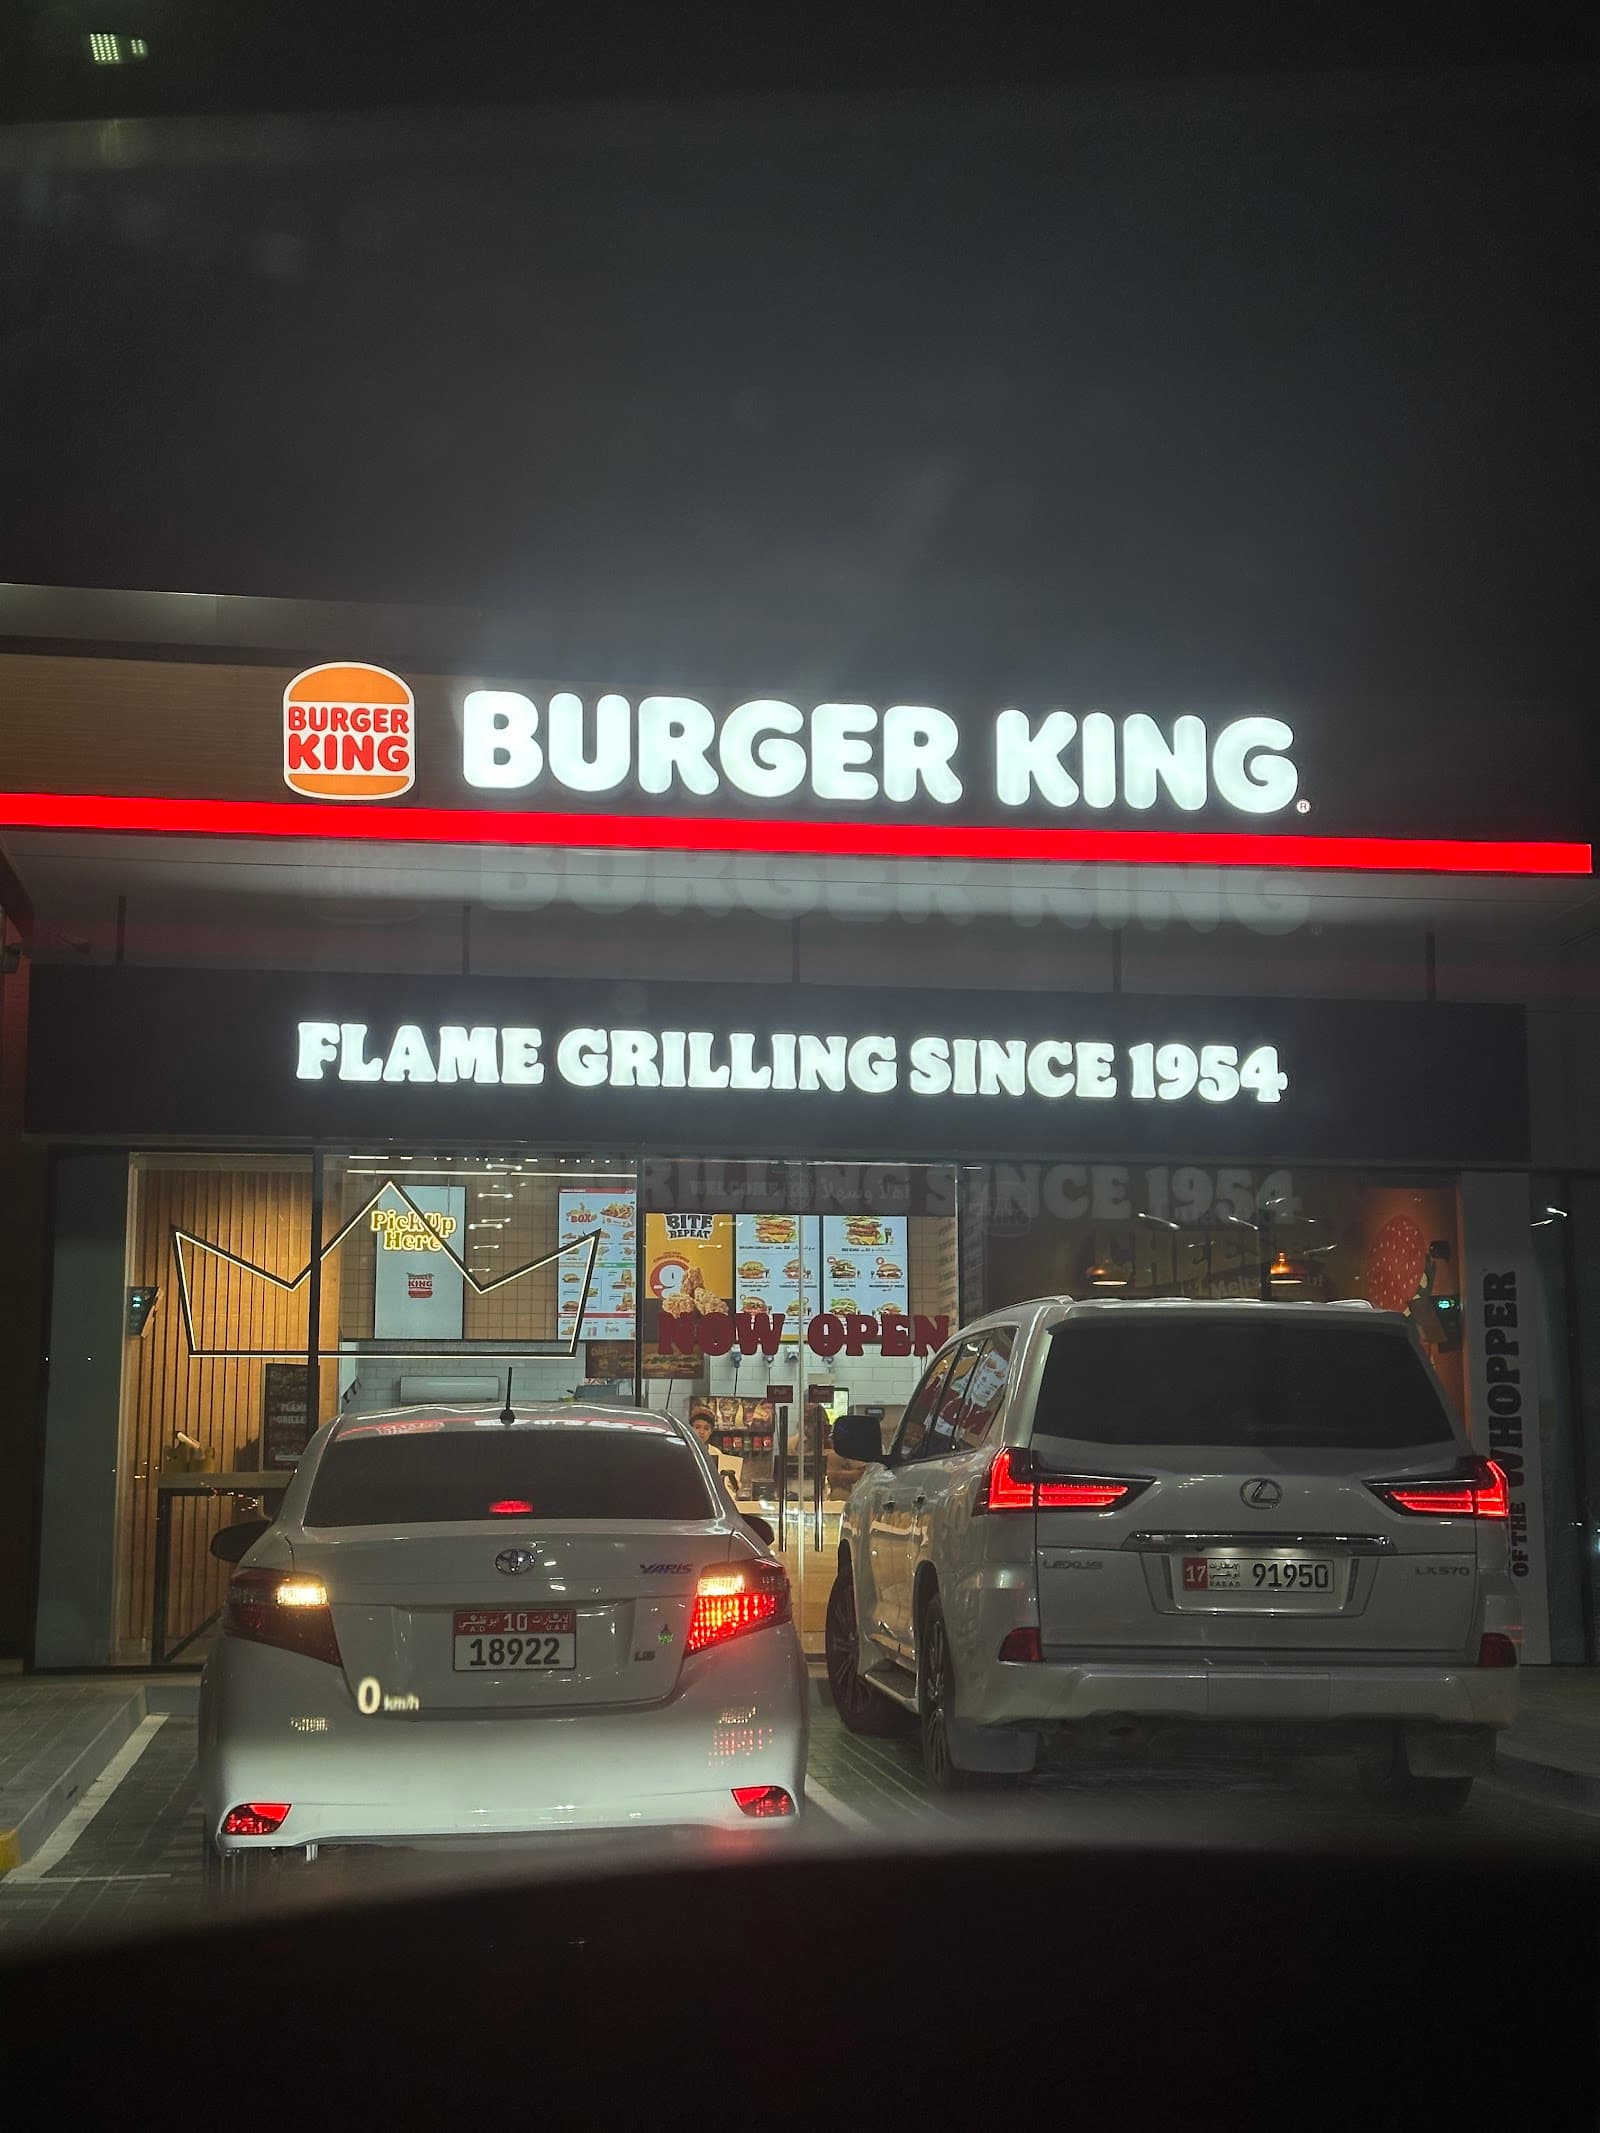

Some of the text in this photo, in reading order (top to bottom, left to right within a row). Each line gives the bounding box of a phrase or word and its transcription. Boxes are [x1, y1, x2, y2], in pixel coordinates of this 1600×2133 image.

[289, 706, 410, 734] BURGER
[288, 733, 410, 772] KING
[461, 688, 1299, 814] BURGER KING
[296, 1022, 1288, 1103] FLAME GRILLING SINCE 1954
[666, 1214, 713, 1229] BITE
[667, 1229, 711, 1239] REPEAT
[384, 1230, 442, 1251] Here
[658, 1312, 949, 1356] NOW OPEN
[1483, 1270, 1525, 1488] WHOPPER
[640, 1563, 693, 1574] YARIS
[1185, 1563, 1329, 1588] 17 91950
[503, 1613, 528, 1632] 10
[470, 1638, 560, 1666] 18922
[358, 1676, 419, 1715] 0 km/h
